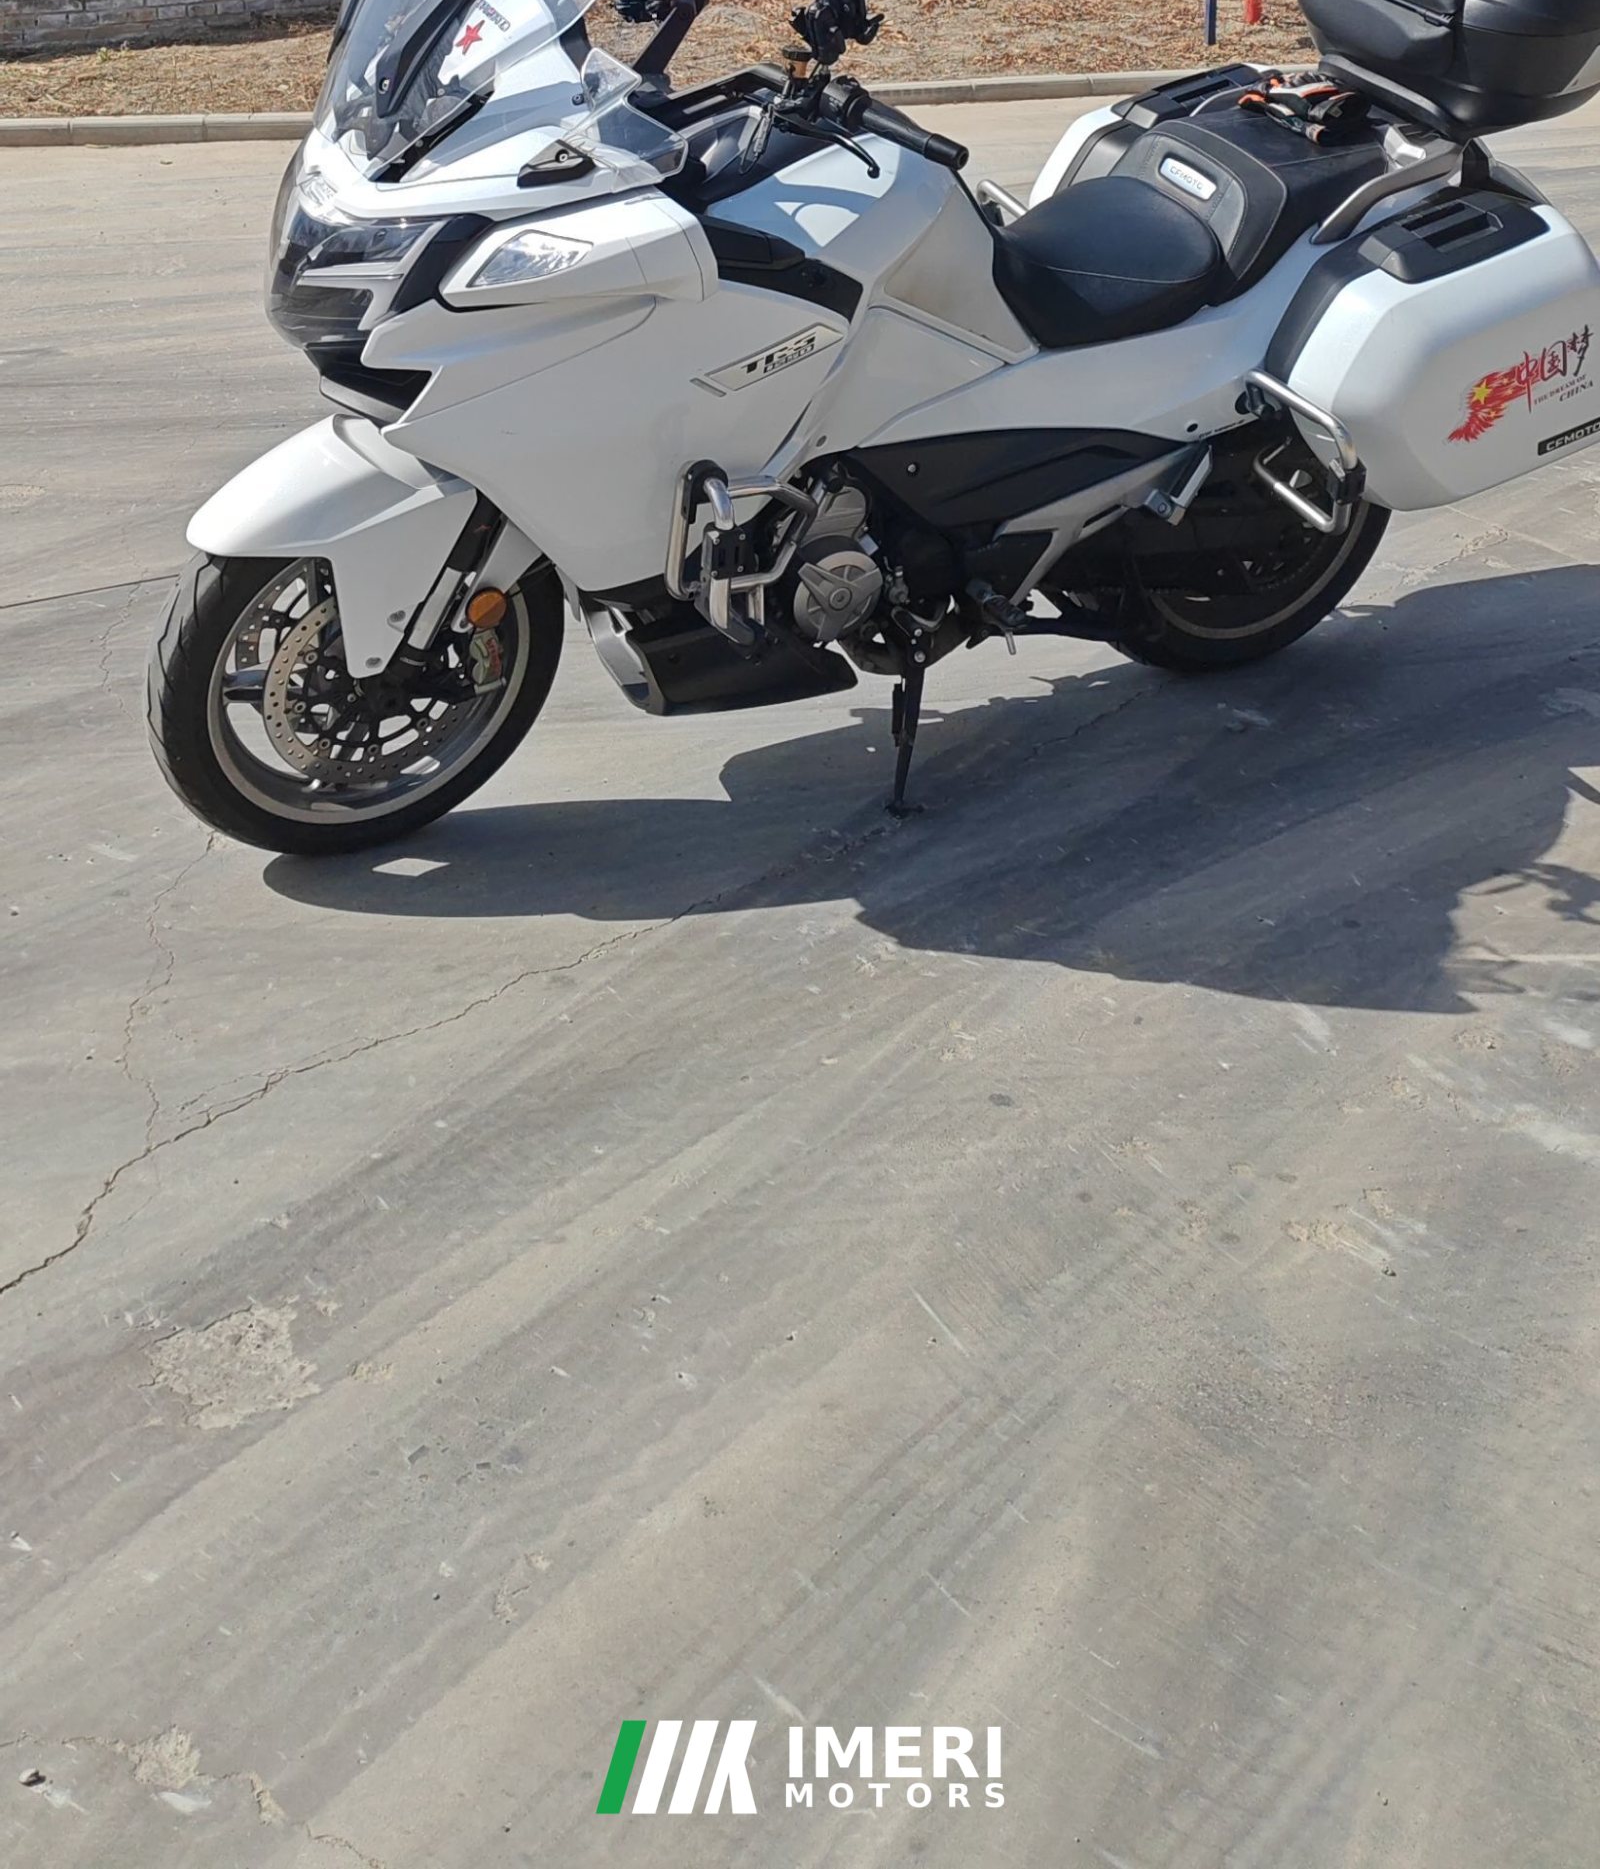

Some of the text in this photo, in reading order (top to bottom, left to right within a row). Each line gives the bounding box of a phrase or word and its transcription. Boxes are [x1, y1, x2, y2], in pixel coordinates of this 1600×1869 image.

[1516, 324, 1594, 413] 中国梦
[1559, 379, 1594, 402] CHINA
[1545, 421, 1600, 451] CFMOTO
